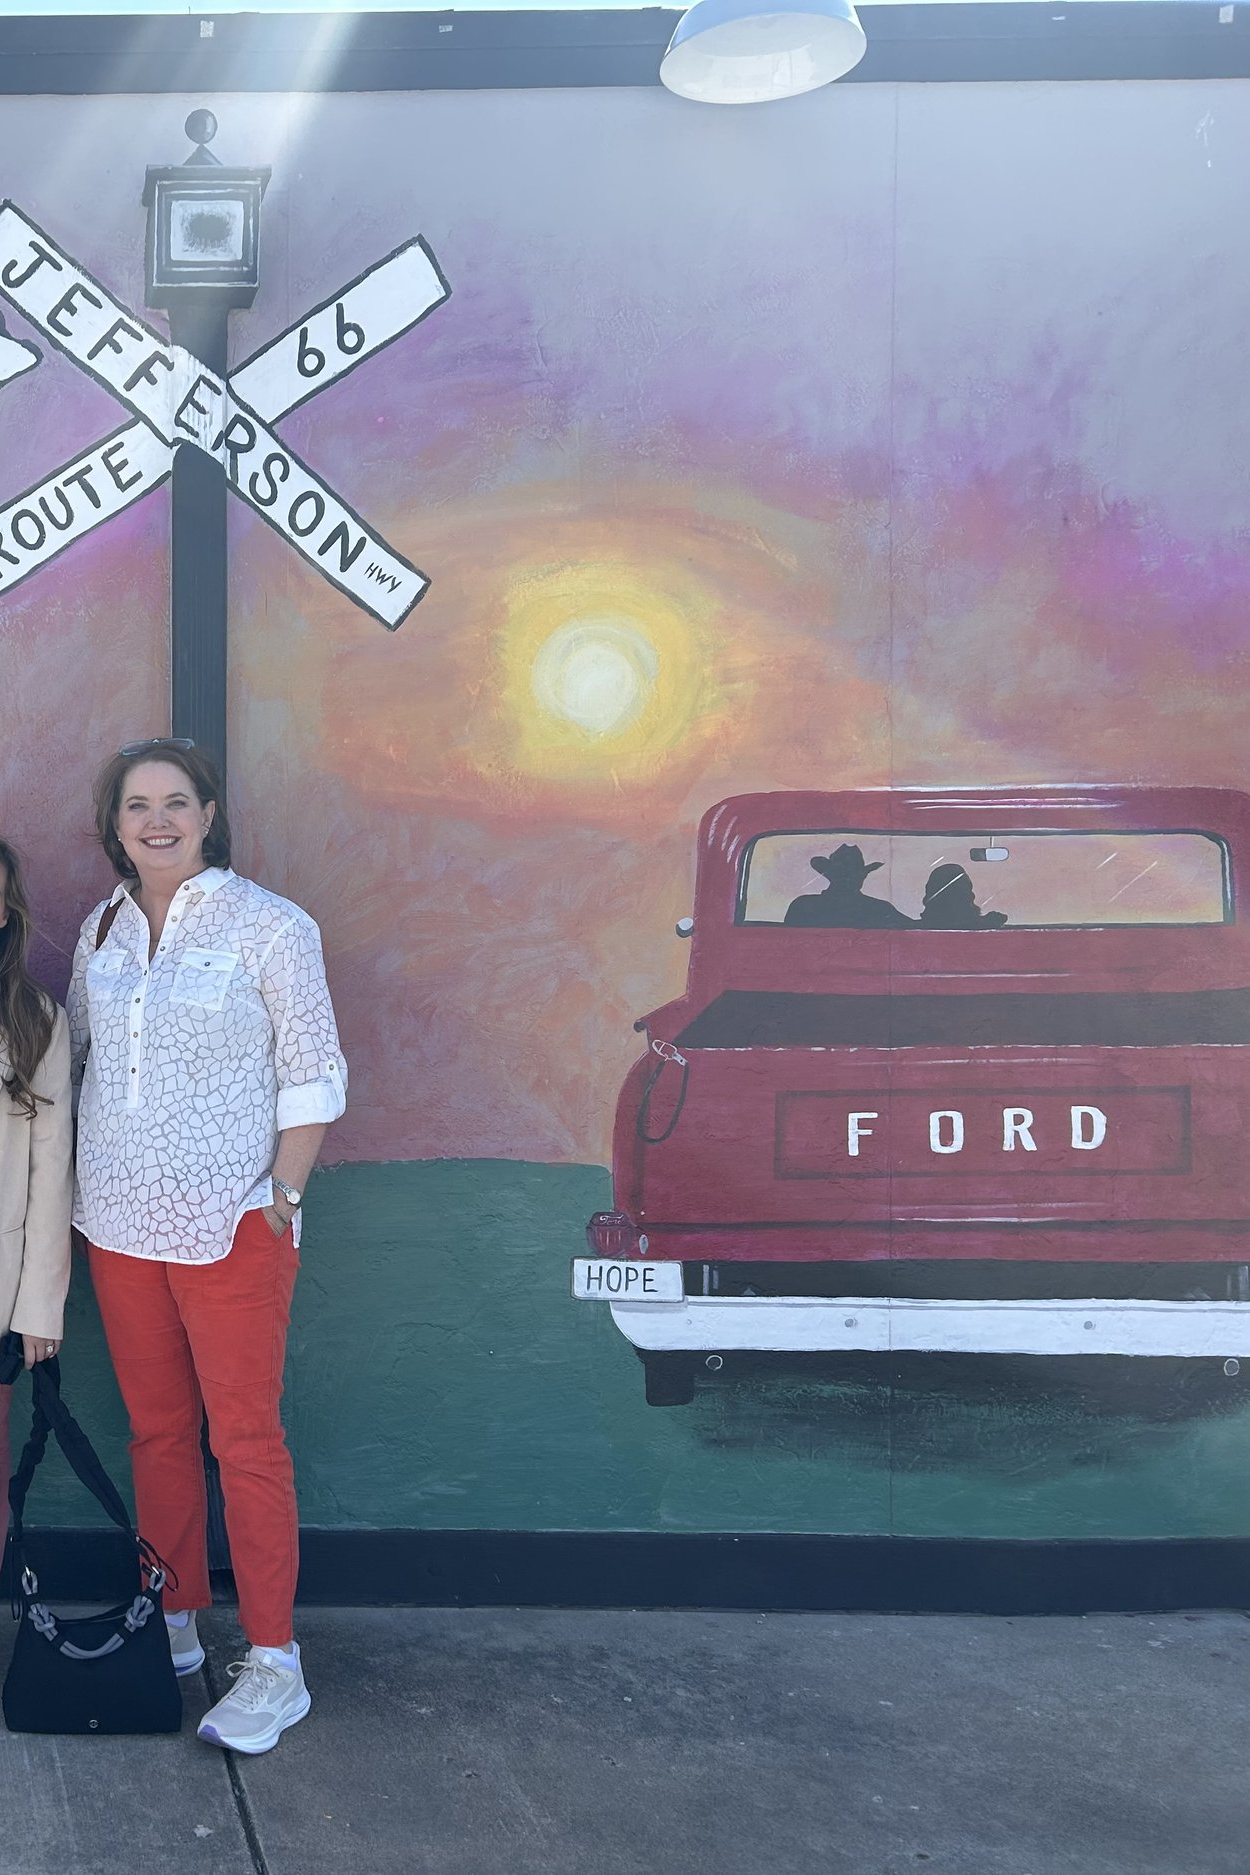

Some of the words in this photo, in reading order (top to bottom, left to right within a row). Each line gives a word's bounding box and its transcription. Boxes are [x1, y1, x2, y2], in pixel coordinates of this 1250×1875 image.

[296, 302, 366, 378] 66
[1, 240, 368, 573] JEFFERSON
[364, 561, 403, 594] HWY
[847, 1105, 1108, 1157] FORD
[586, 1265, 659, 1293] HOPE
